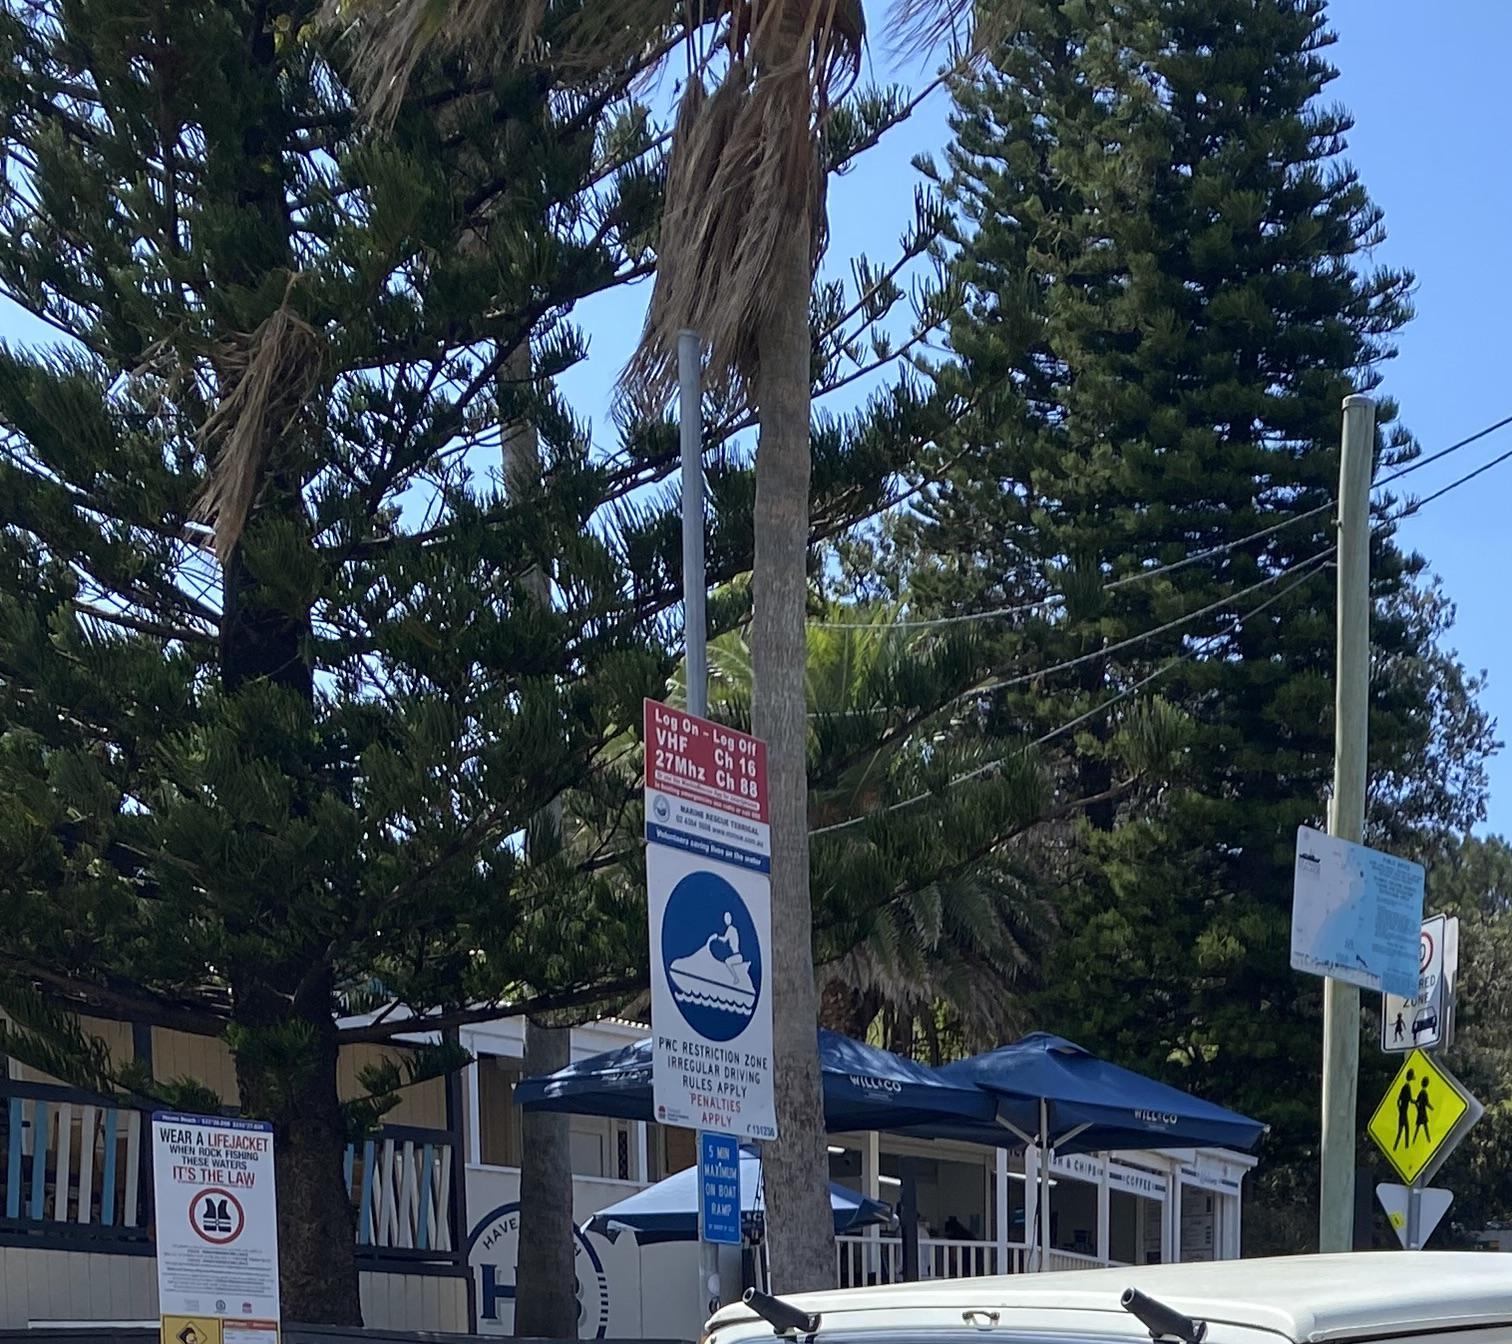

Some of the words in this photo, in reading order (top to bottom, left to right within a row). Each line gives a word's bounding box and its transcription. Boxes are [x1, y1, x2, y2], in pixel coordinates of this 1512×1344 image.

[655, 708, 678, 732] Log
[682, 718, 699, 736] On
[713, 729, 735, 749] Log
[739, 739, 756, 757] Off
[656, 727, 688, 753] VHF
[714, 748, 733, 770] Ch
[739, 756, 756, 777] 16
[655, 750, 705, 781] 27Mhz
[716, 769, 735, 791] Ch
[740, 778, 758, 798] 88
[680, 804, 704, 819] MARINE
[705, 812, 729, 827] RESCUE
[658, 1036, 678, 1053] PWC
[682, 1042, 740, 1065] RESTRICTION
[744, 1053, 768, 1071] ZONE
[667, 1055, 720, 1077] IRREGULAR
[724, 1068, 761, 1085] DRIVING
[682, 1074, 713, 1092] RULES
[717, 1081, 747, 1098] APPLY
[690, 1092, 741, 1113] PENALTIES
[701, 1111, 732, 1128] APPLY
[160, 1127, 192, 1144] WEAR
[196, 1132, 204, 1146] A
[208, 1132, 269, 1152] LIFEJACKET
[169, 1144, 196, 1155] WHEN
[199, 1147, 222, 1158] ROCK
[225, 1150, 259, 1161] FISHING
[182, 1156, 209, 1167] THESE
[212, 1159, 247, 1170] WATERS
[709, 1145, 714, 1159] 5
[717, 1146, 730, 1161] MIN
[172, 1165, 196, 1181] IT'S
[200, 1168, 224, 1183] THE
[228, 1170, 256, 1187] LAW
[703, 1165, 737, 1180] MAXIMUM
[1074, 1160, 1096, 1176] CHIPS
[705, 1183, 716, 1197] ON
[718, 1184, 737, 1199] BOAT
[1126, 1175, 1151, 1191] COFFEE
[711, 1202, 732, 1217] RAMP
